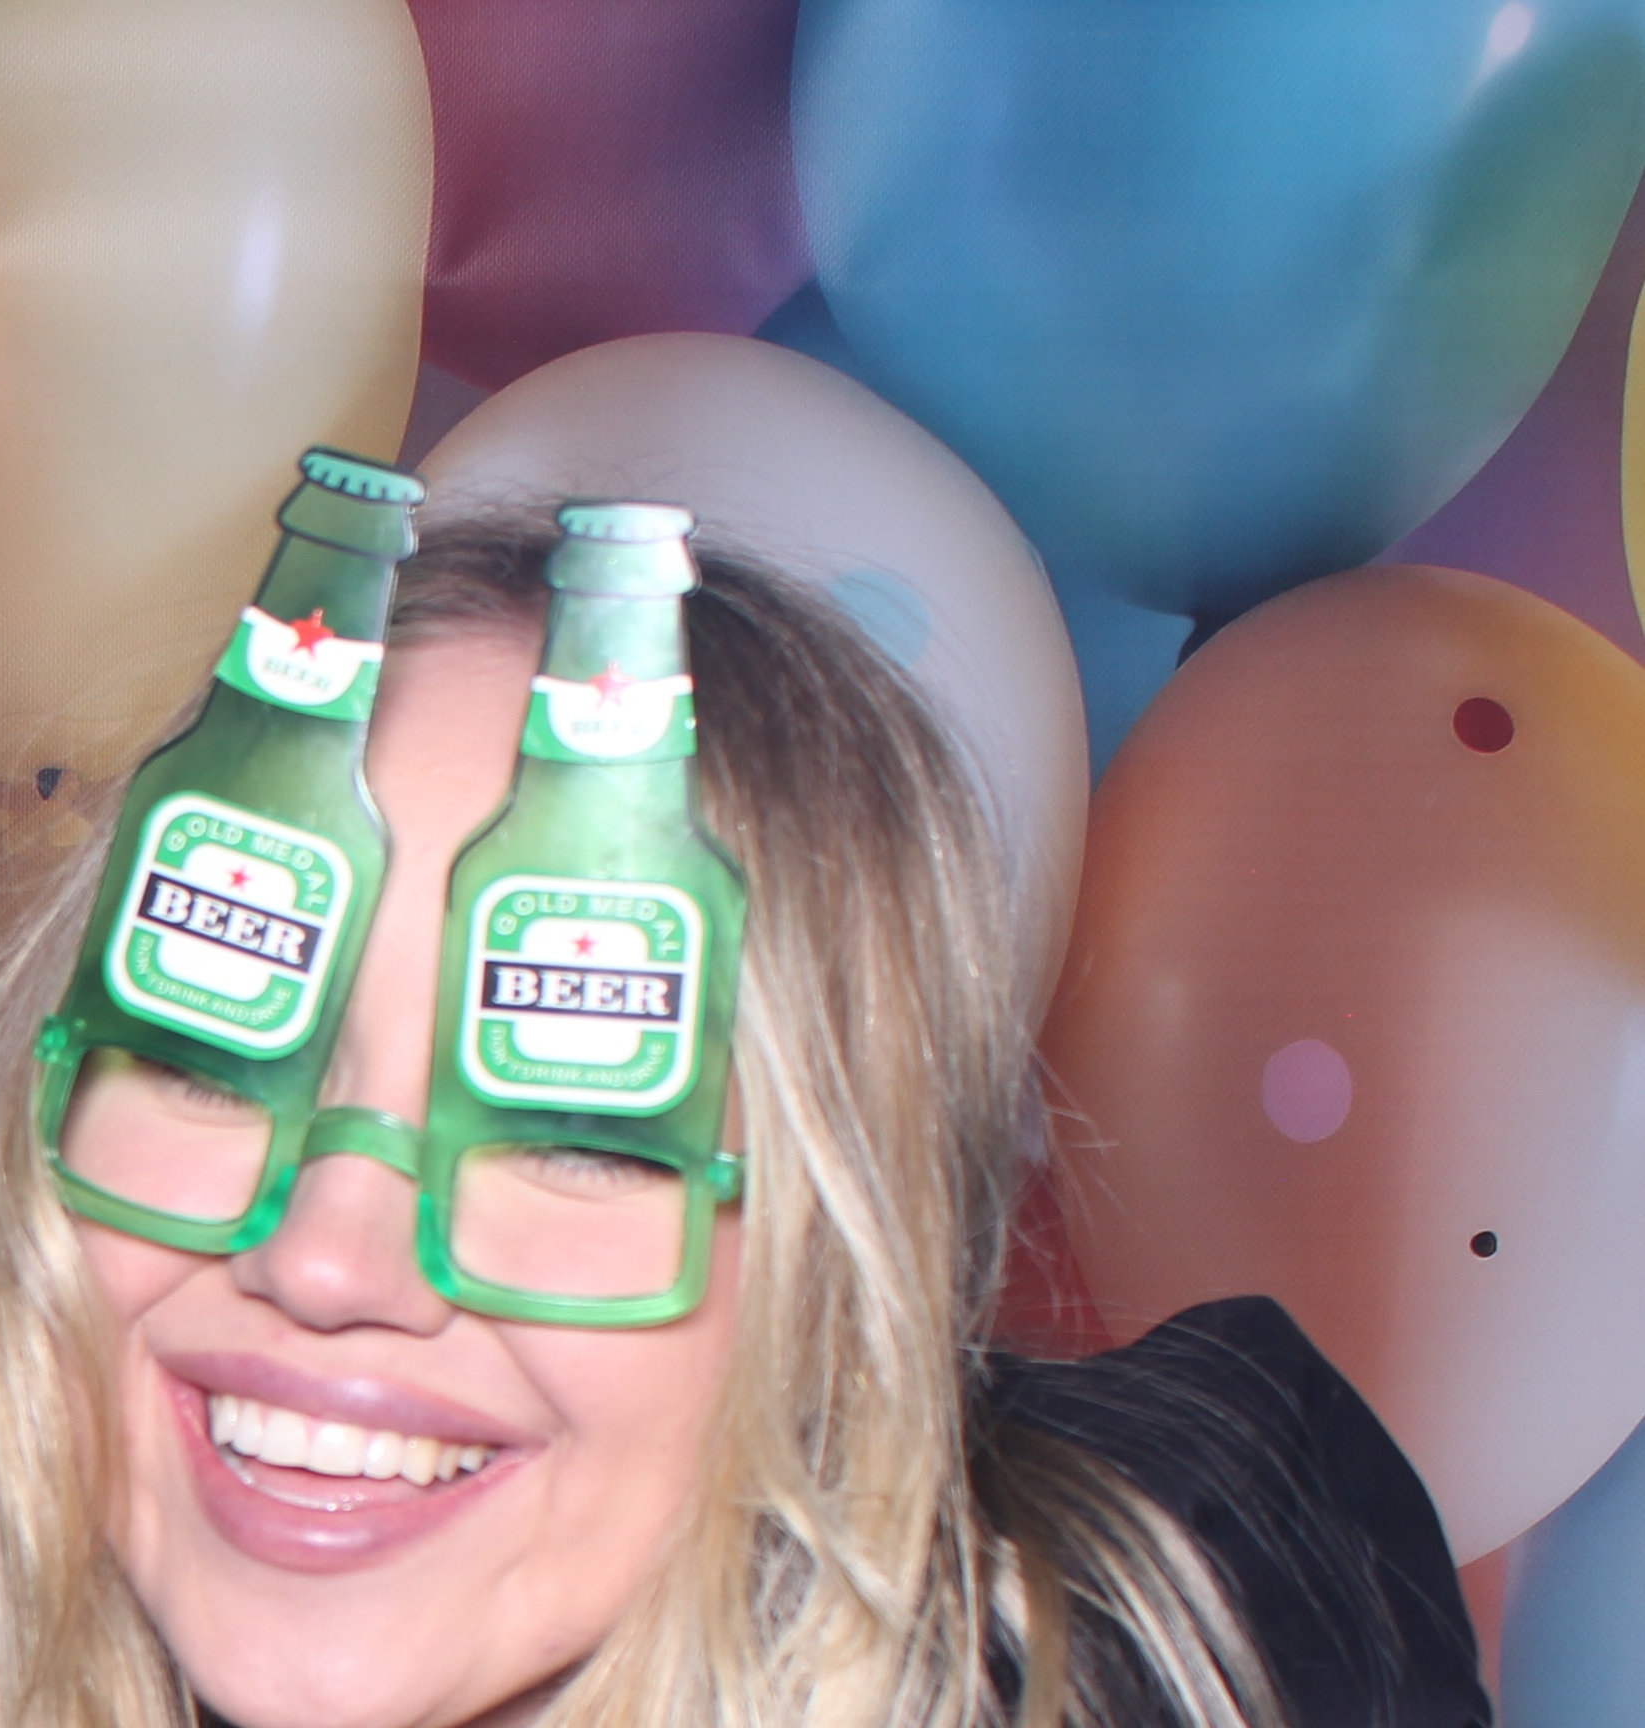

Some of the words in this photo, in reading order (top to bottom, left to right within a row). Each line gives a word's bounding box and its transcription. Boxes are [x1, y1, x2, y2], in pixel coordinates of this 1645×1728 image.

[164, 815, 244, 853] GOLD
[250, 833, 328, 911] MEDAL
[146, 879, 308, 966] BEER
[492, 892, 580, 937] GOLD
[589, 896, 681, 960] MEDAL
[491, 966, 671, 1016] BEER
